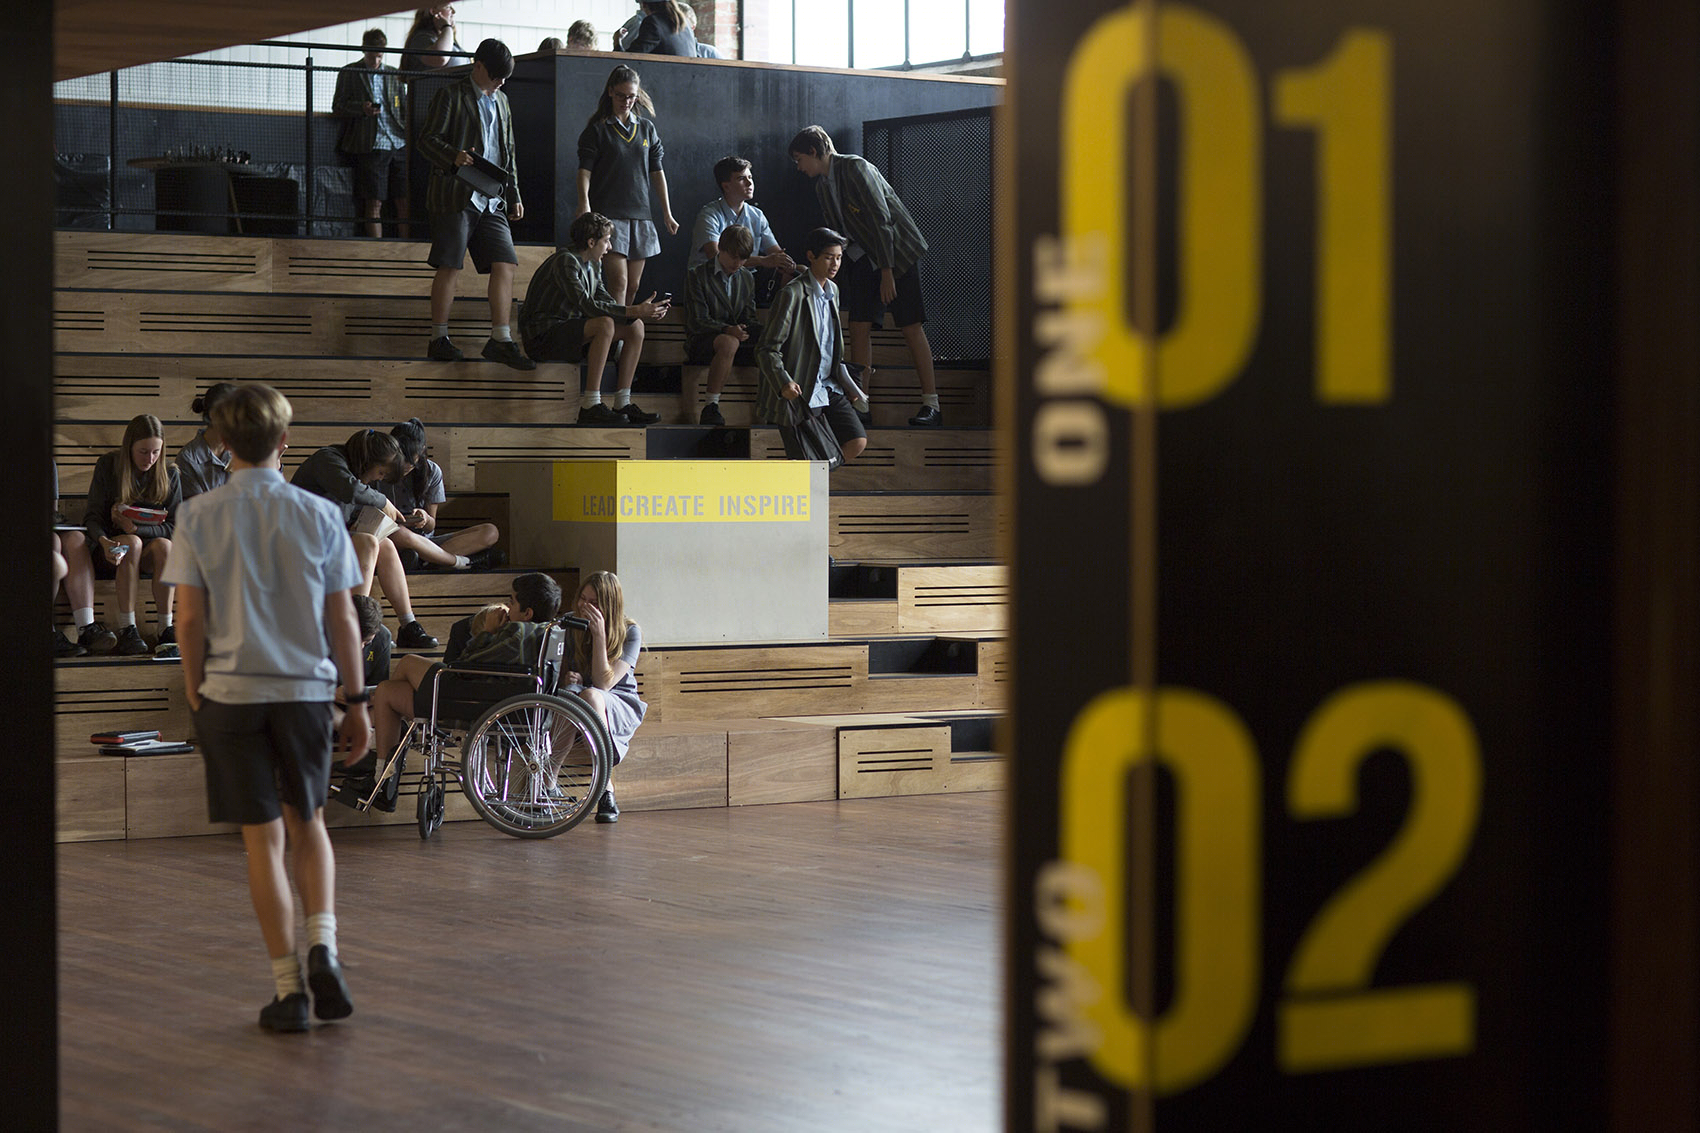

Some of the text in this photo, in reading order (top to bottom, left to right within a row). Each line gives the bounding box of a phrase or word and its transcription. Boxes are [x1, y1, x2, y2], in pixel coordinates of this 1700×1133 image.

[1062, 6, 1393, 409] 01
[1034, 232, 1110, 485] ONE
[583, 495, 808, 516] LEAD CREATE INSPIRE
[1036, 861, 1106, 1133] TWO
[1061, 679, 1484, 1095] 02
